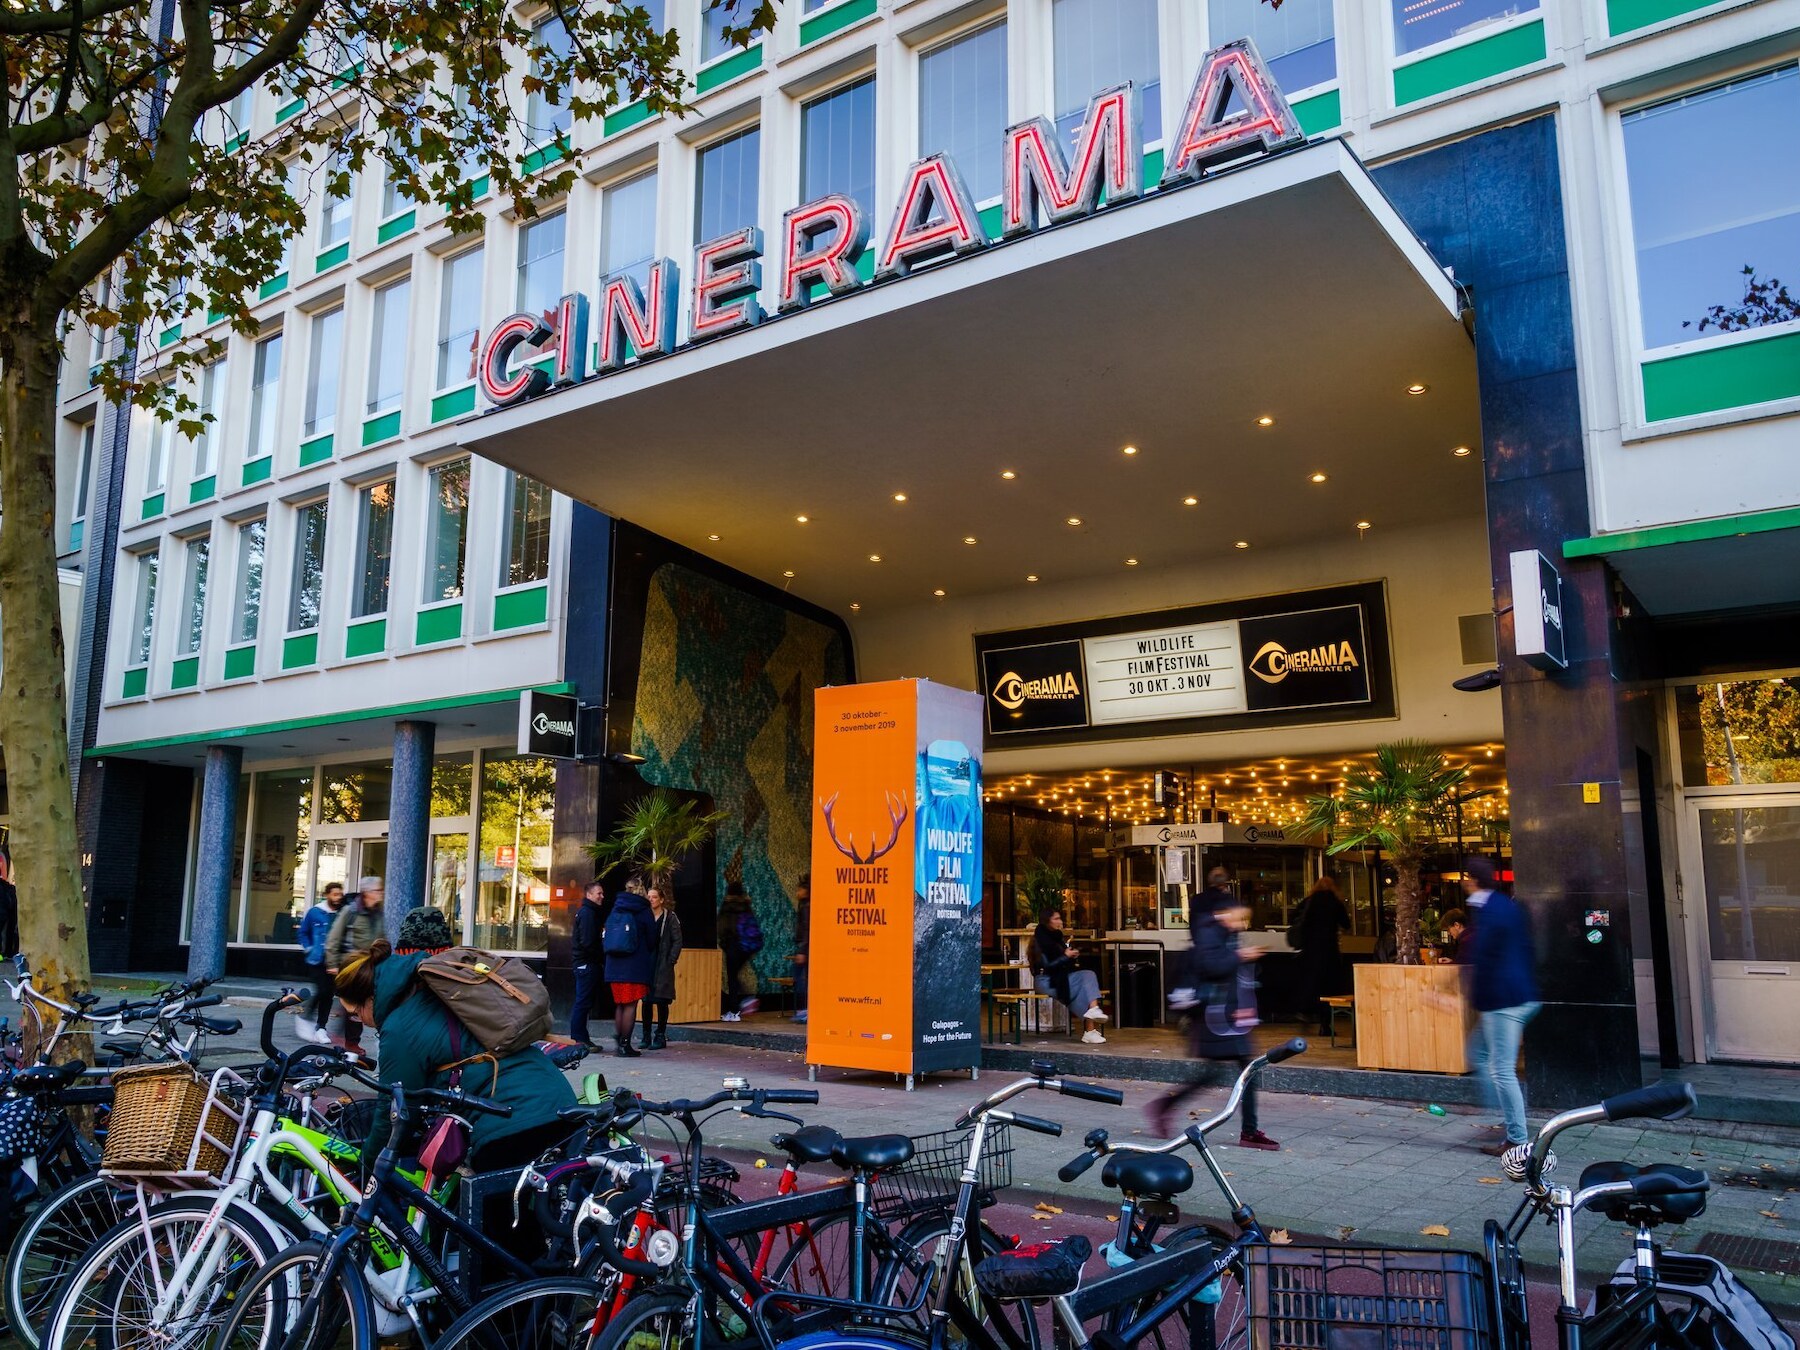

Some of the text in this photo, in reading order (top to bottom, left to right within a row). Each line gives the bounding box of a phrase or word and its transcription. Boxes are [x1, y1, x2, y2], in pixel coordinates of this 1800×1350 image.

[478, 36, 1306, 407] CINERAMA
[1137, 635, 1194, 654] WILDLIFE
[1268, 641, 1359, 674] CINERAMA
[1292, 665, 1352, 673] FILMTHEATER
[1008, 671, 1080, 701] CINERAMA
[1129, 681, 1144, 695] 30
[1177, 676, 1185, 690] 3
[1188, 674, 1211, 688] NOV
[841, 712, 851, 720] 30
[852, 710, 881, 720] oktober
[833, 720, 896, 733] 3 november 2019
[927, 827, 973, 854] WILDLIFE
[82, 853, 92, 867] 14
[938, 855, 962, 879] FILM
[836, 867, 889, 884] WILDLIFE
[848, 887, 876, 905] FILM
[927, 881, 972, 906] FESTIVAL
[837, 907, 887, 925] FESTIVAL
[847, 928, 876, 937] ROTTERDAM
[838, 996, 882, 1005] www.wffr.nl
[922, 1031, 972, 1044] Hope for the Future
[191, 1204, 221, 1253] BATAVUS
